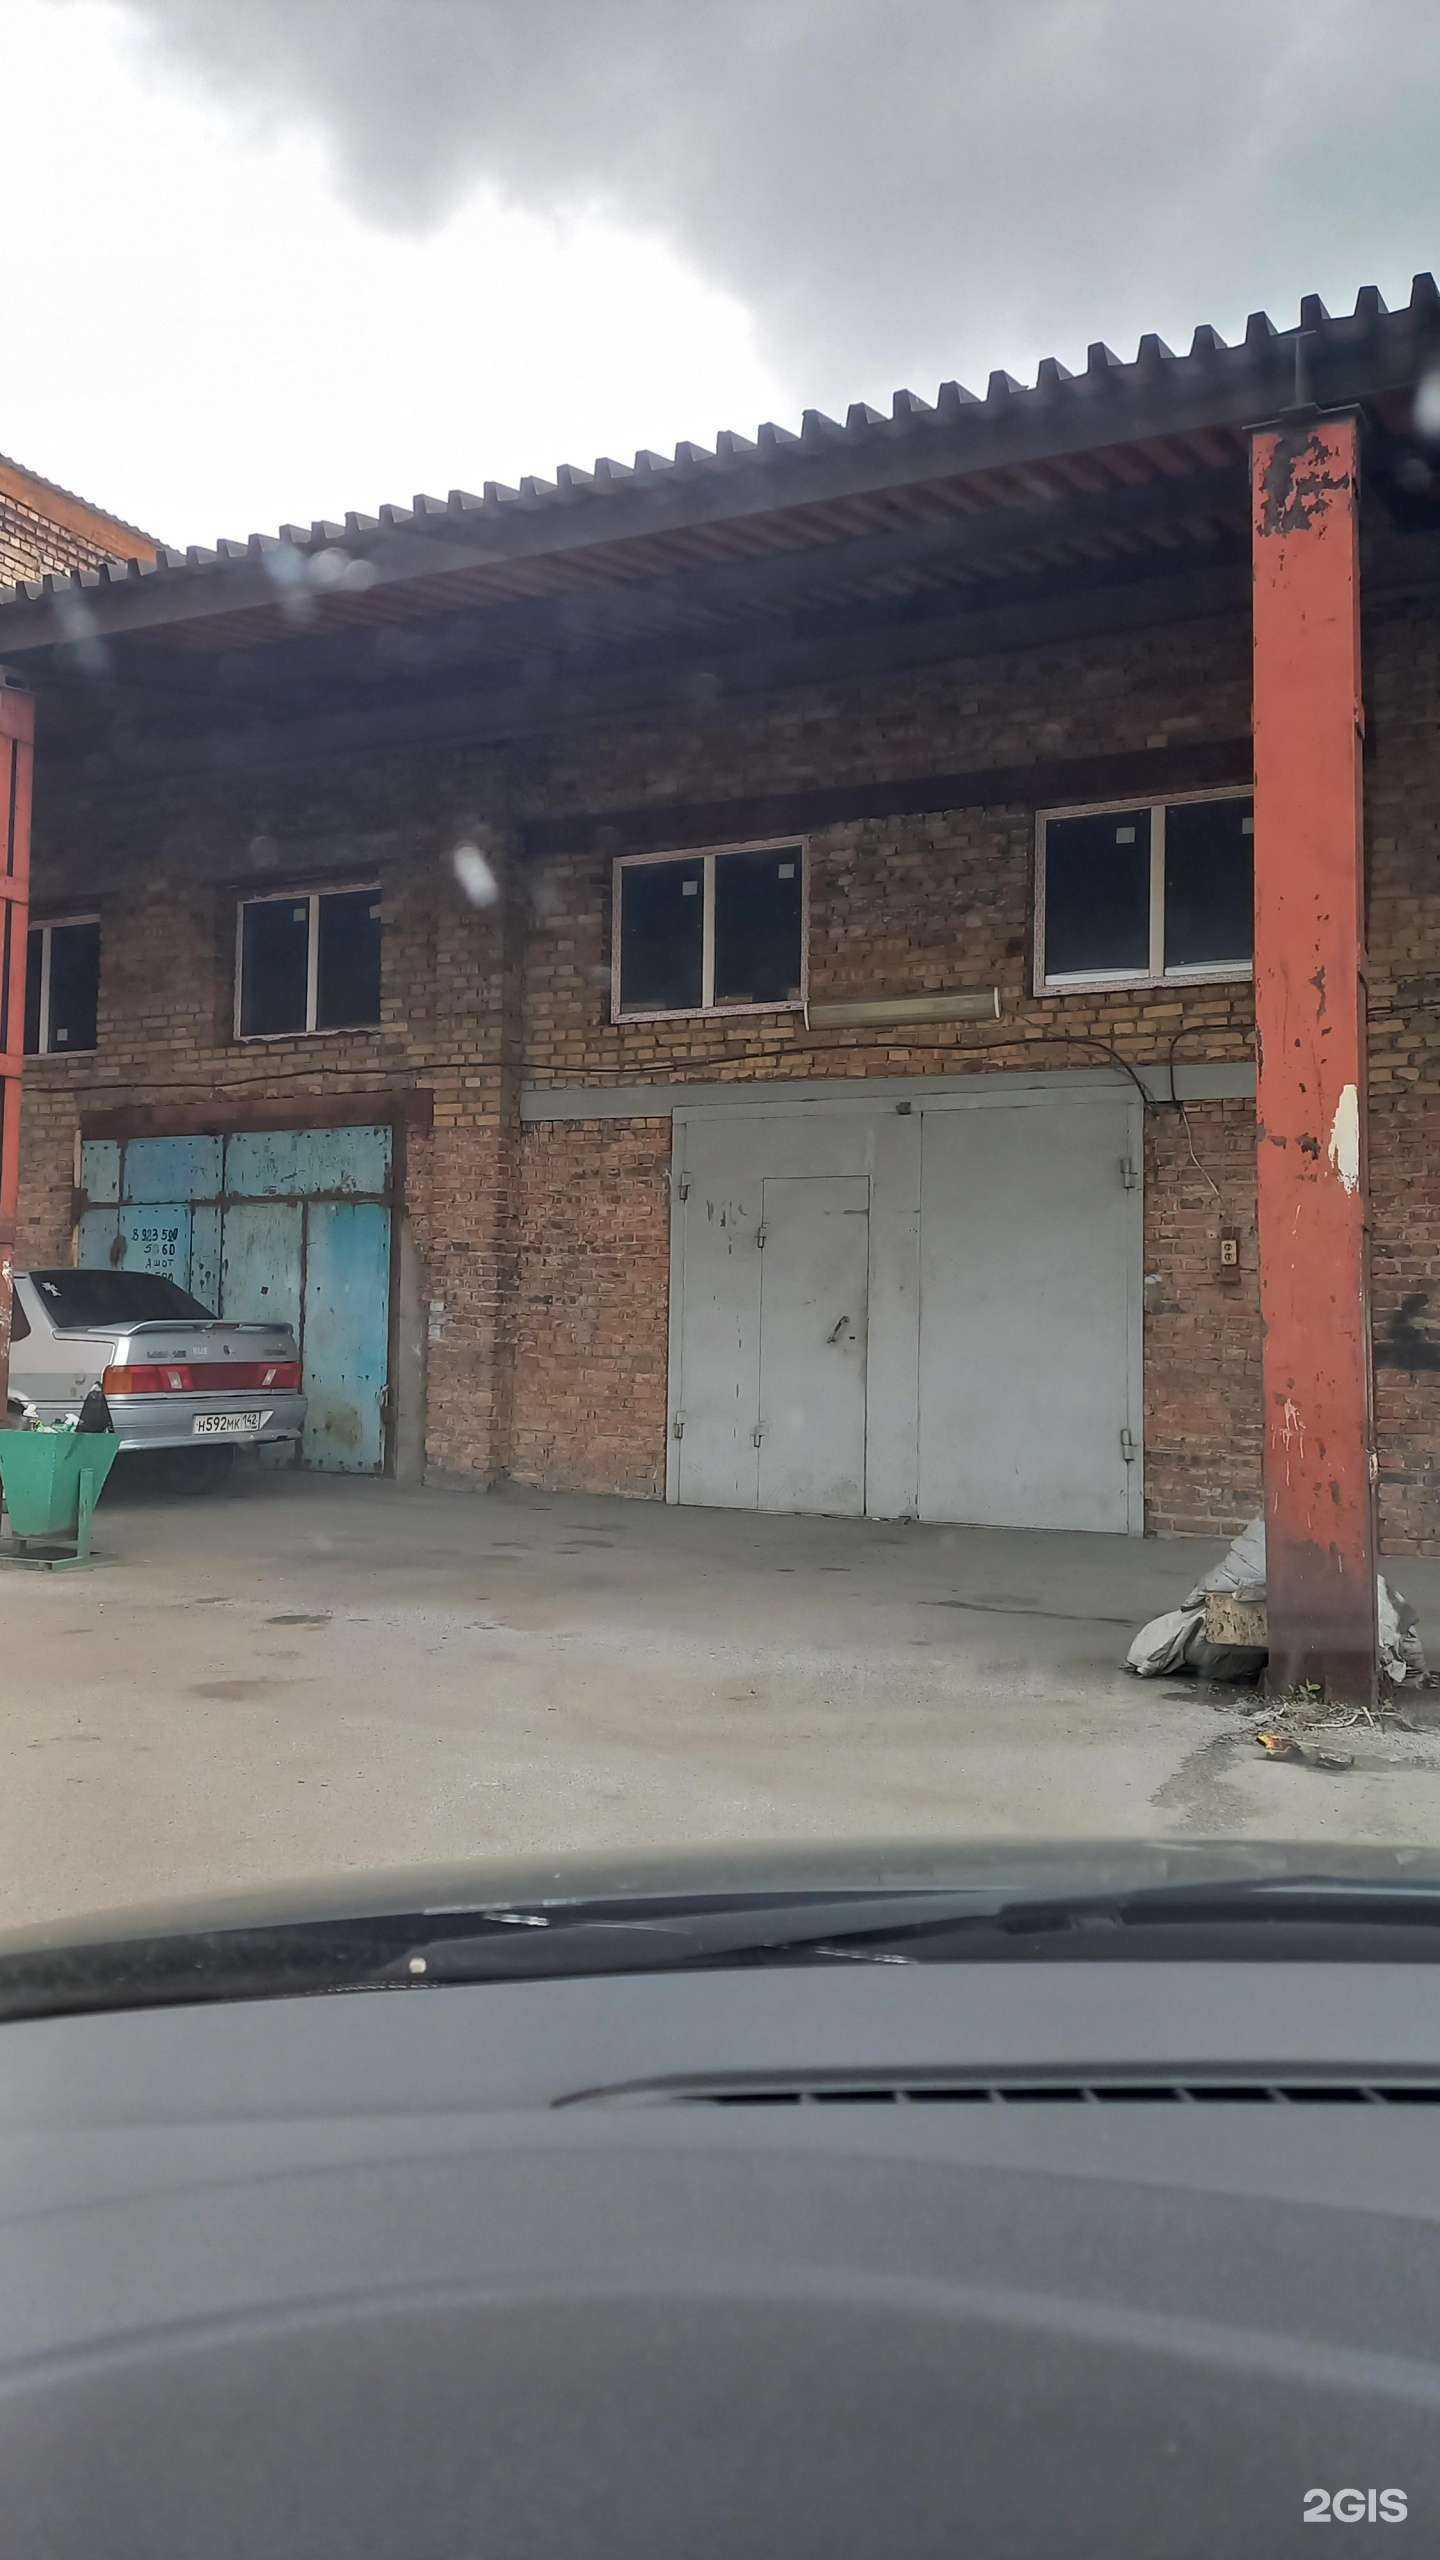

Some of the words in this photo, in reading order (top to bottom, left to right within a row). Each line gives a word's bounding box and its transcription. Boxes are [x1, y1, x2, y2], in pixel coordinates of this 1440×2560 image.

[131, 1228, 139, 1241] 8
[142, 1228, 158, 1242] 923
[162, 1244, 175, 1256] 60
[243, 1414, 257, 1425] 142
